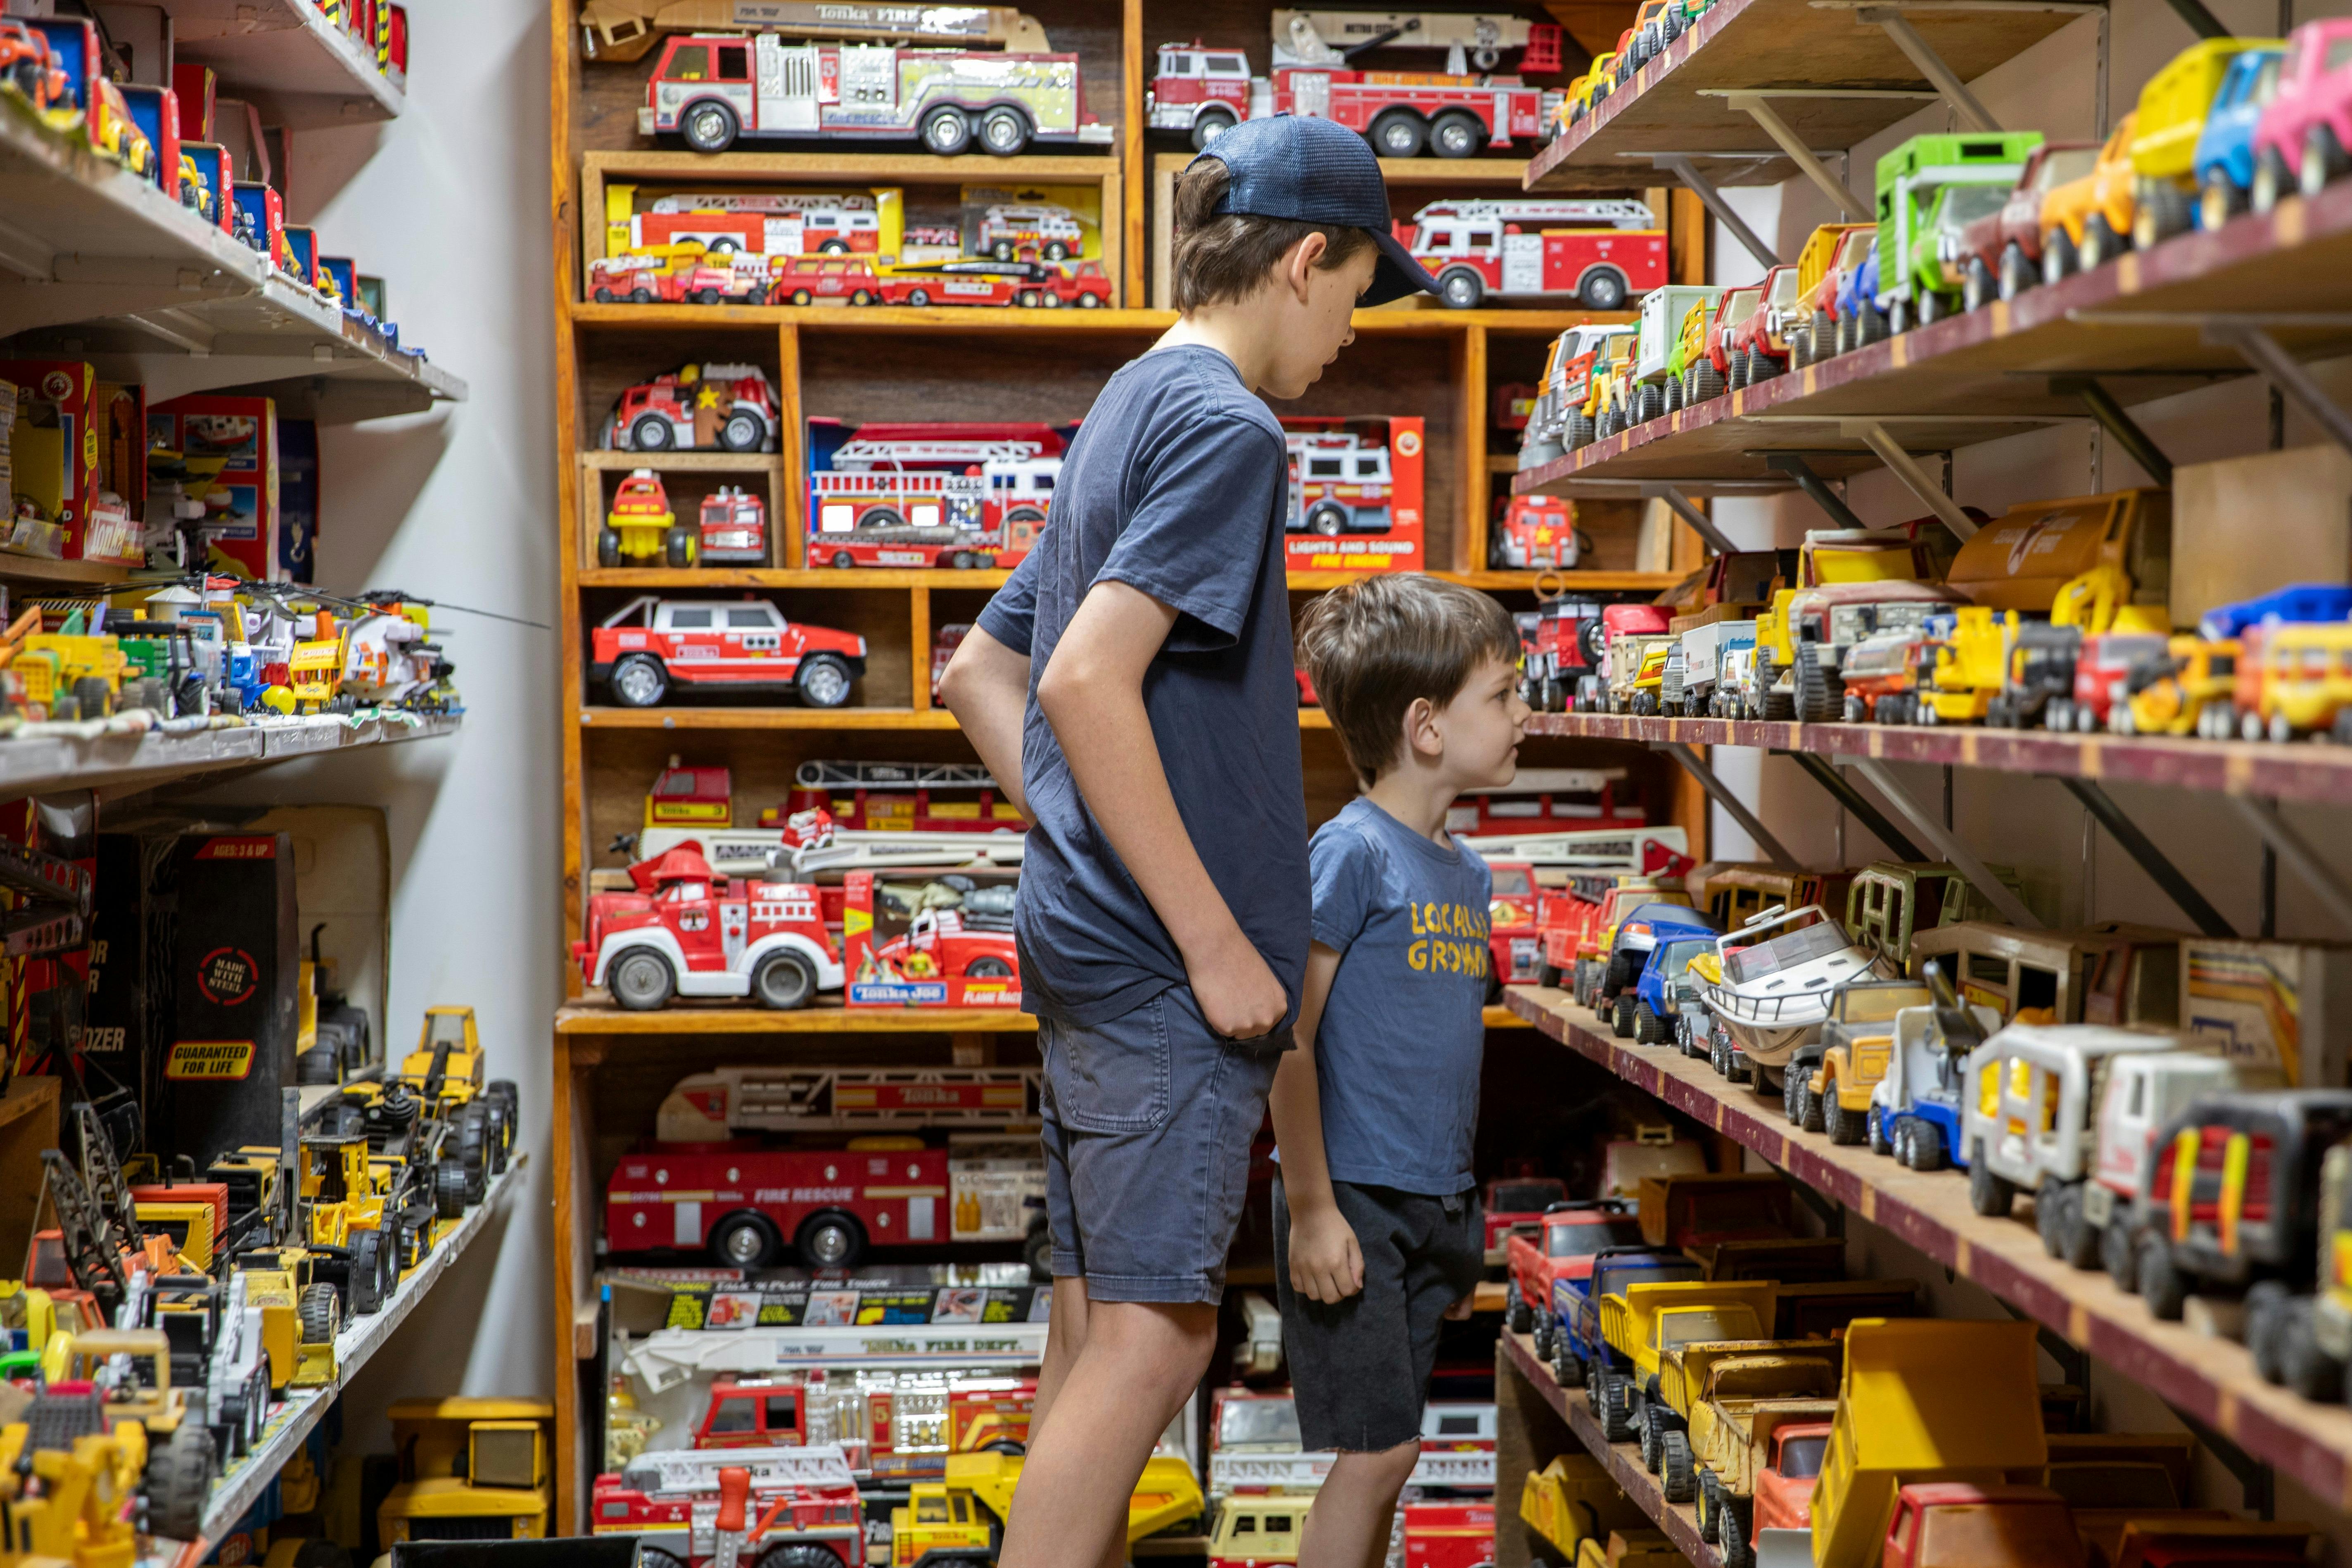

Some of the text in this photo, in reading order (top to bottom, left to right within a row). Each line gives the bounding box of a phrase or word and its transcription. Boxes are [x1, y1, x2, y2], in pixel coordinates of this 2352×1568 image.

[1289, 541, 1415, 555] LIGHTS AND SOUND
[1311, 553, 1393, 568] FIRE ENGINE
[240, 845, 246, 856] 3
[255, 844, 268, 856] UP
[1407, 939, 1487, 979] GROWN
[856, 985, 941, 999] Tonka Joe
[174, 1045, 247, 1059] GUARANTEED
[182, 1061, 234, 1074] FOR LIFE
[899, 1087, 960, 1104] Tonka
